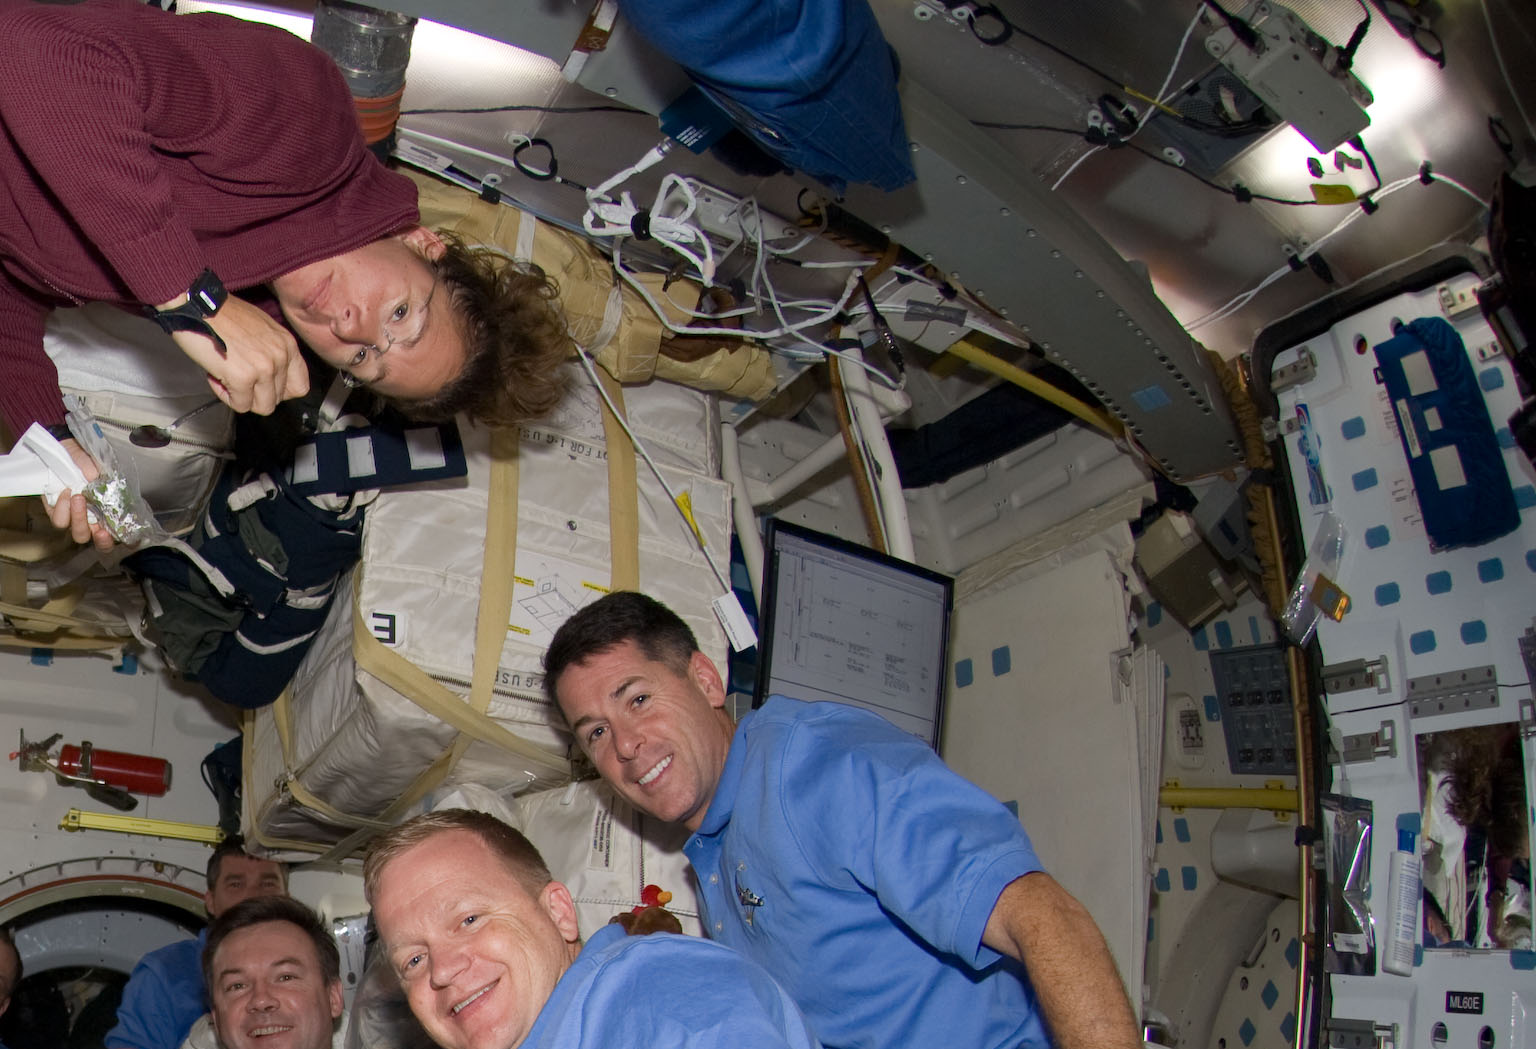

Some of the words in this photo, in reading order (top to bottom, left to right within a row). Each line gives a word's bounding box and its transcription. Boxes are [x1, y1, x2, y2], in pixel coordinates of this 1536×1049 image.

[518, 427, 540, 440] US
[571, 441, 592, 457] FOR
[1450, 995, 1480, 1010] ML60E
